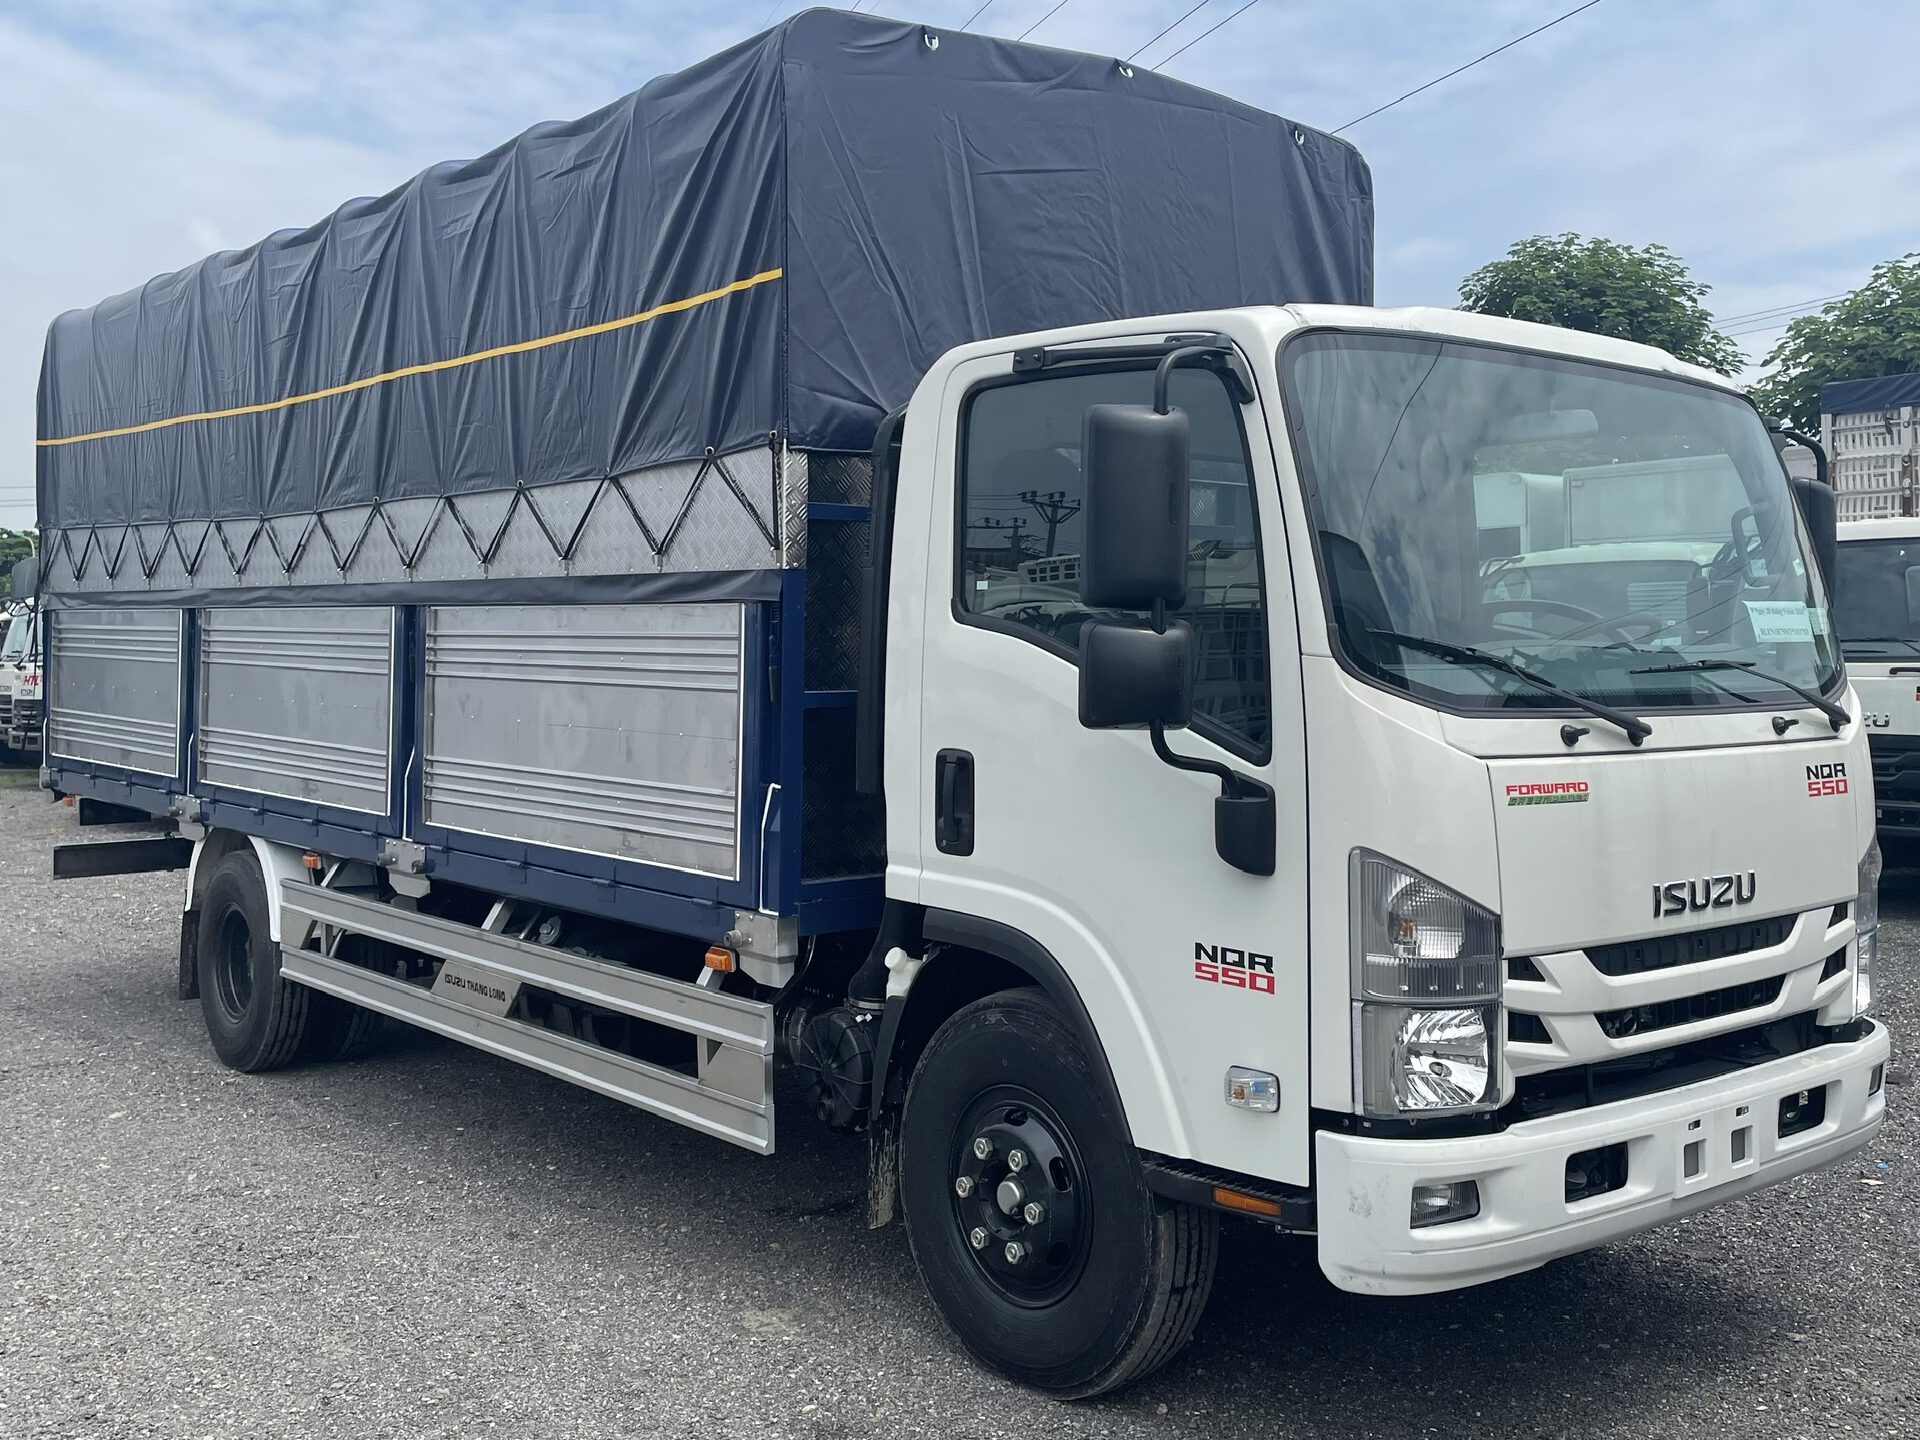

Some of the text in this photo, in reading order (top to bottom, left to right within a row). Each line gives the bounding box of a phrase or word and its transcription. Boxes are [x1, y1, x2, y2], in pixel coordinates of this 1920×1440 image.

[1806, 762, 1847, 780] NQR
[1505, 782, 1589, 796] FORWARD
[1808, 779, 1849, 797] 550
[1653, 868, 1757, 918] ISUZU
[1194, 941, 1274, 974] NQR
[1194, 961, 1275, 995] 550
